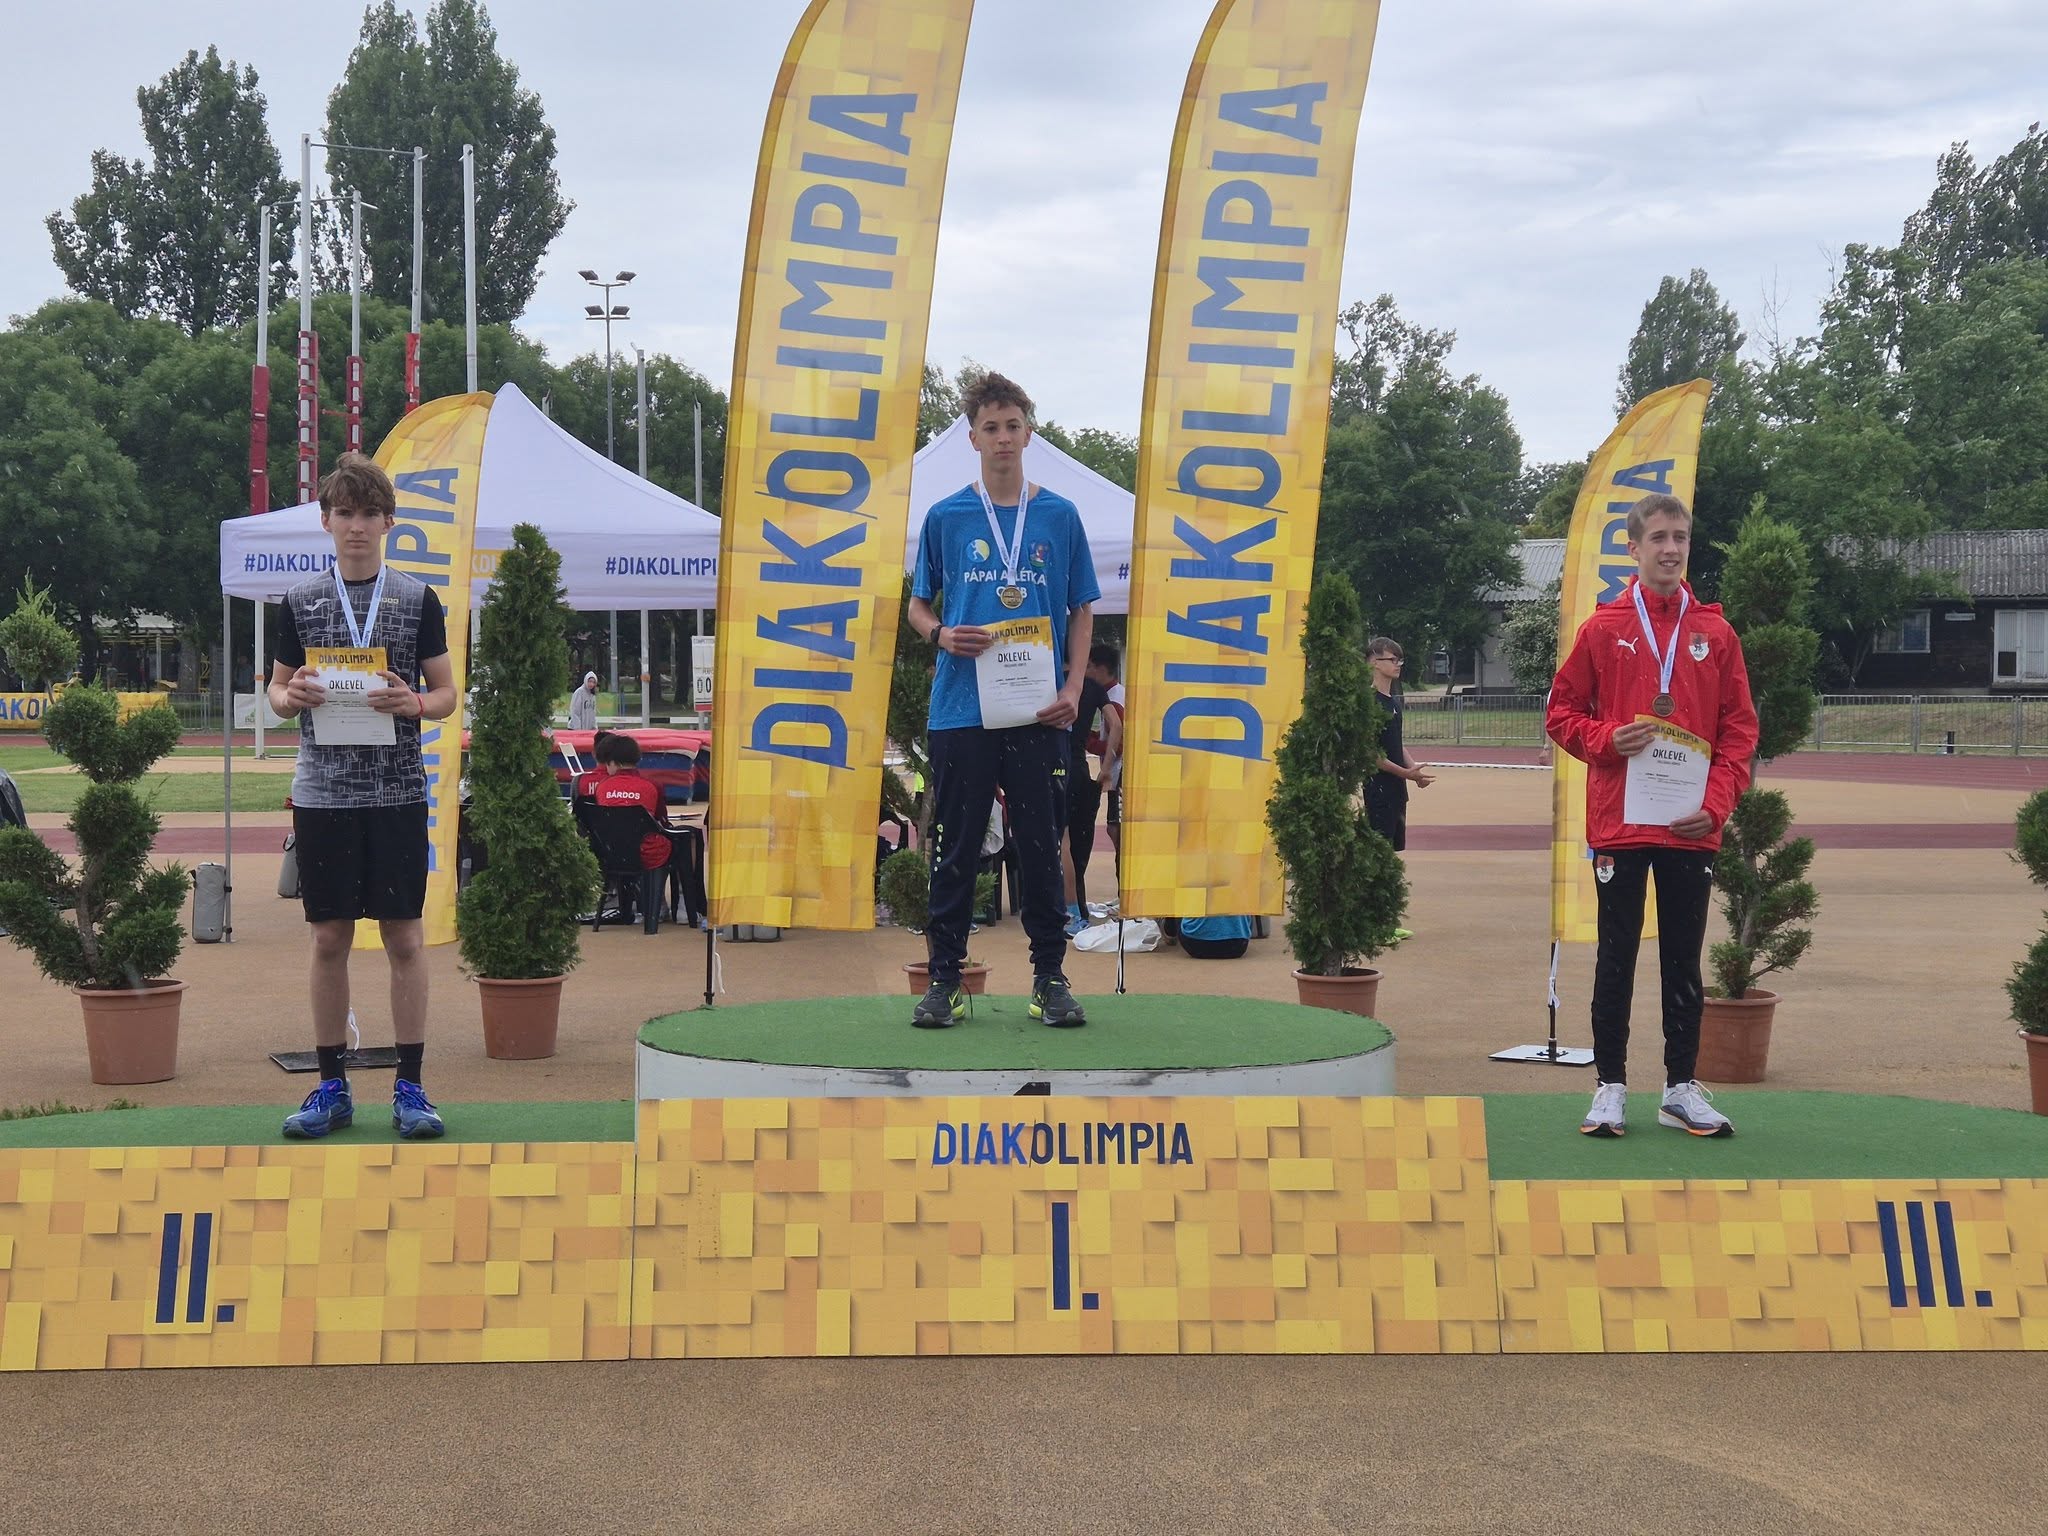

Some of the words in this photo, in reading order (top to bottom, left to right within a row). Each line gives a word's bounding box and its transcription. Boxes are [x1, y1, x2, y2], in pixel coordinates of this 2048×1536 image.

[963, 567, 997, 583] PÁPAI
[605, 789, 641, 800] BÁRDOS
[155, 1212, 235, 1324] II.
[1877, 1201, 1994, 1308] III.
